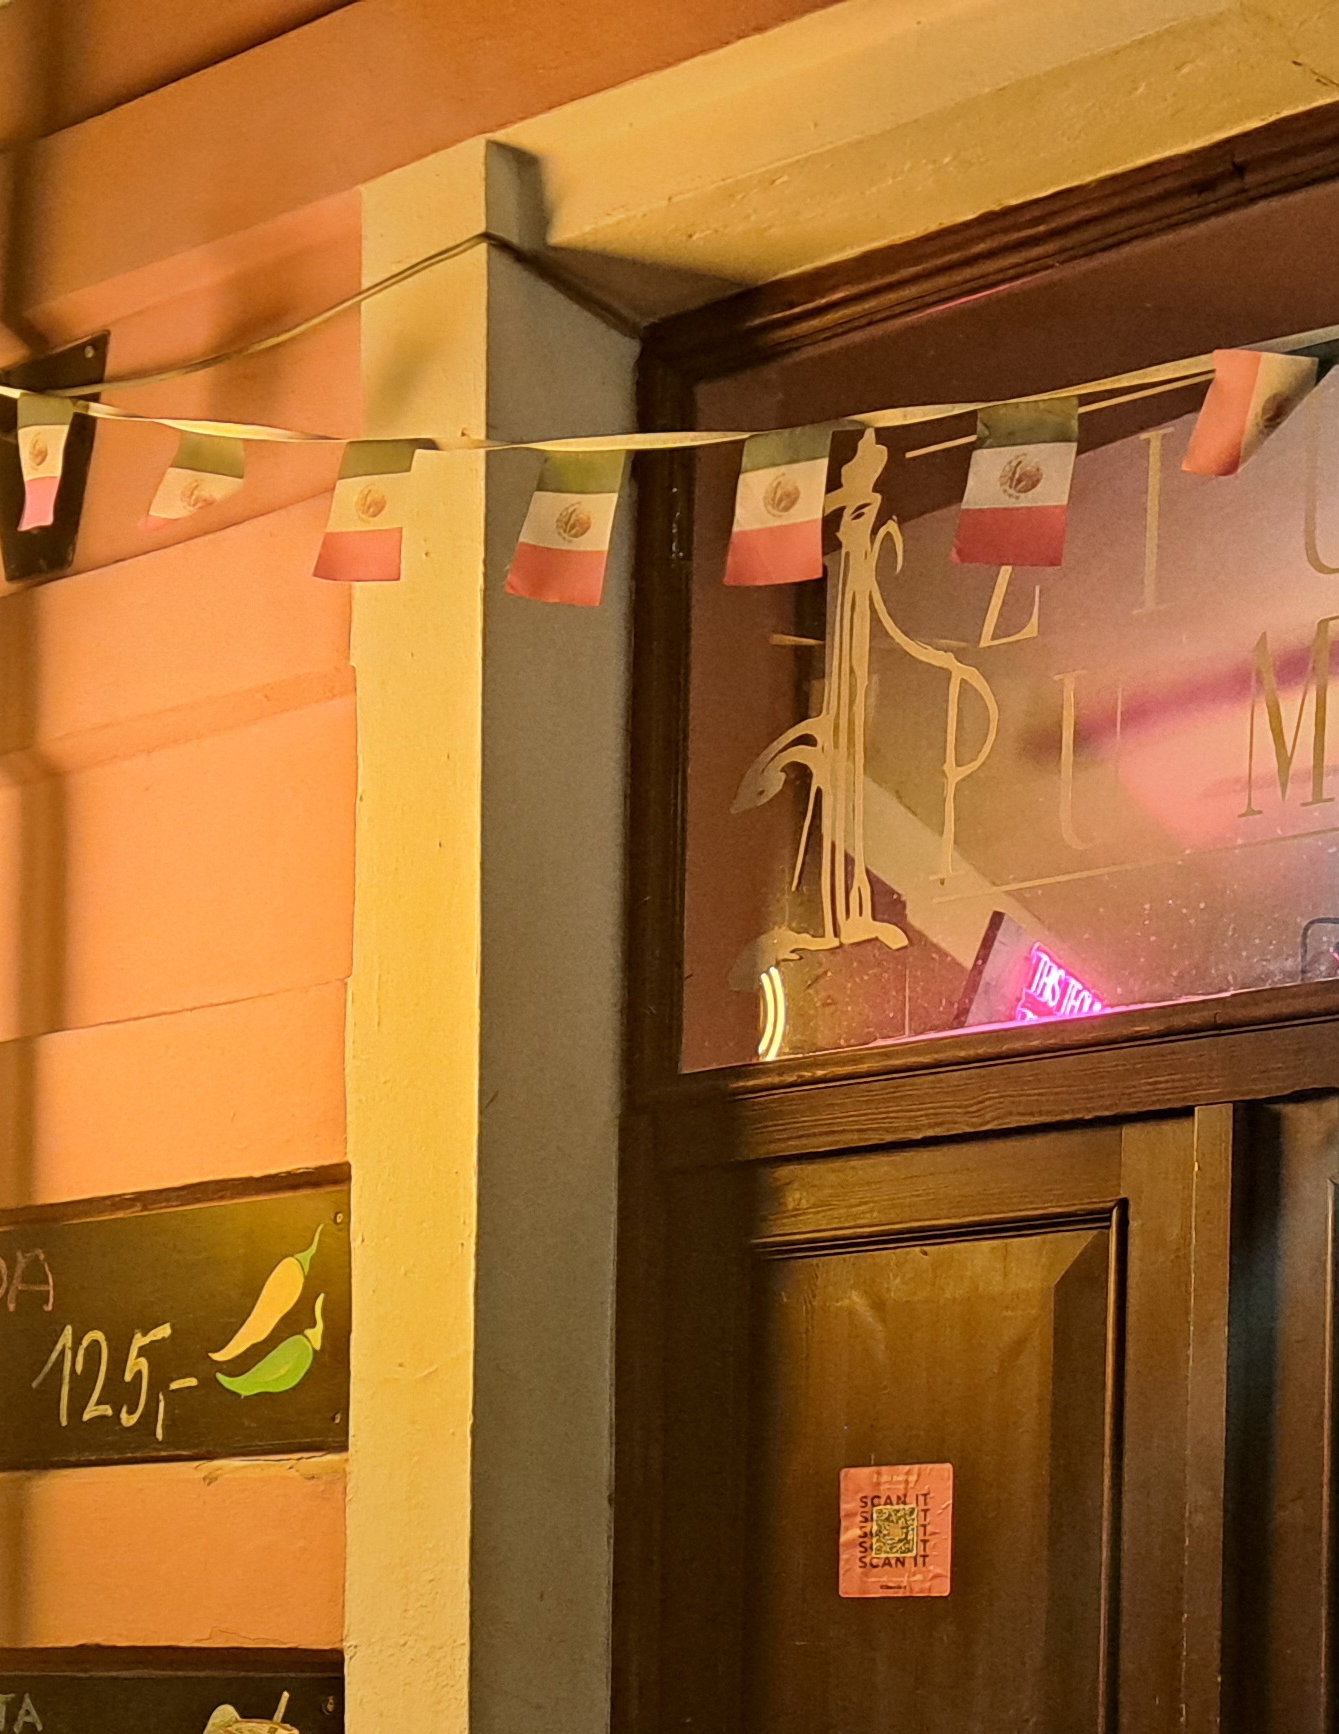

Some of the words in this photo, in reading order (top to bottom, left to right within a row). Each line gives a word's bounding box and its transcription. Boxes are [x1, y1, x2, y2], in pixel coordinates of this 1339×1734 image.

[860, 1494, 907, 1508] SCAN
[916, 1493, 931, 1506] IT
[858, 1555, 906, 1569] SCAN
[913, 1555, 930, 1568] IT
